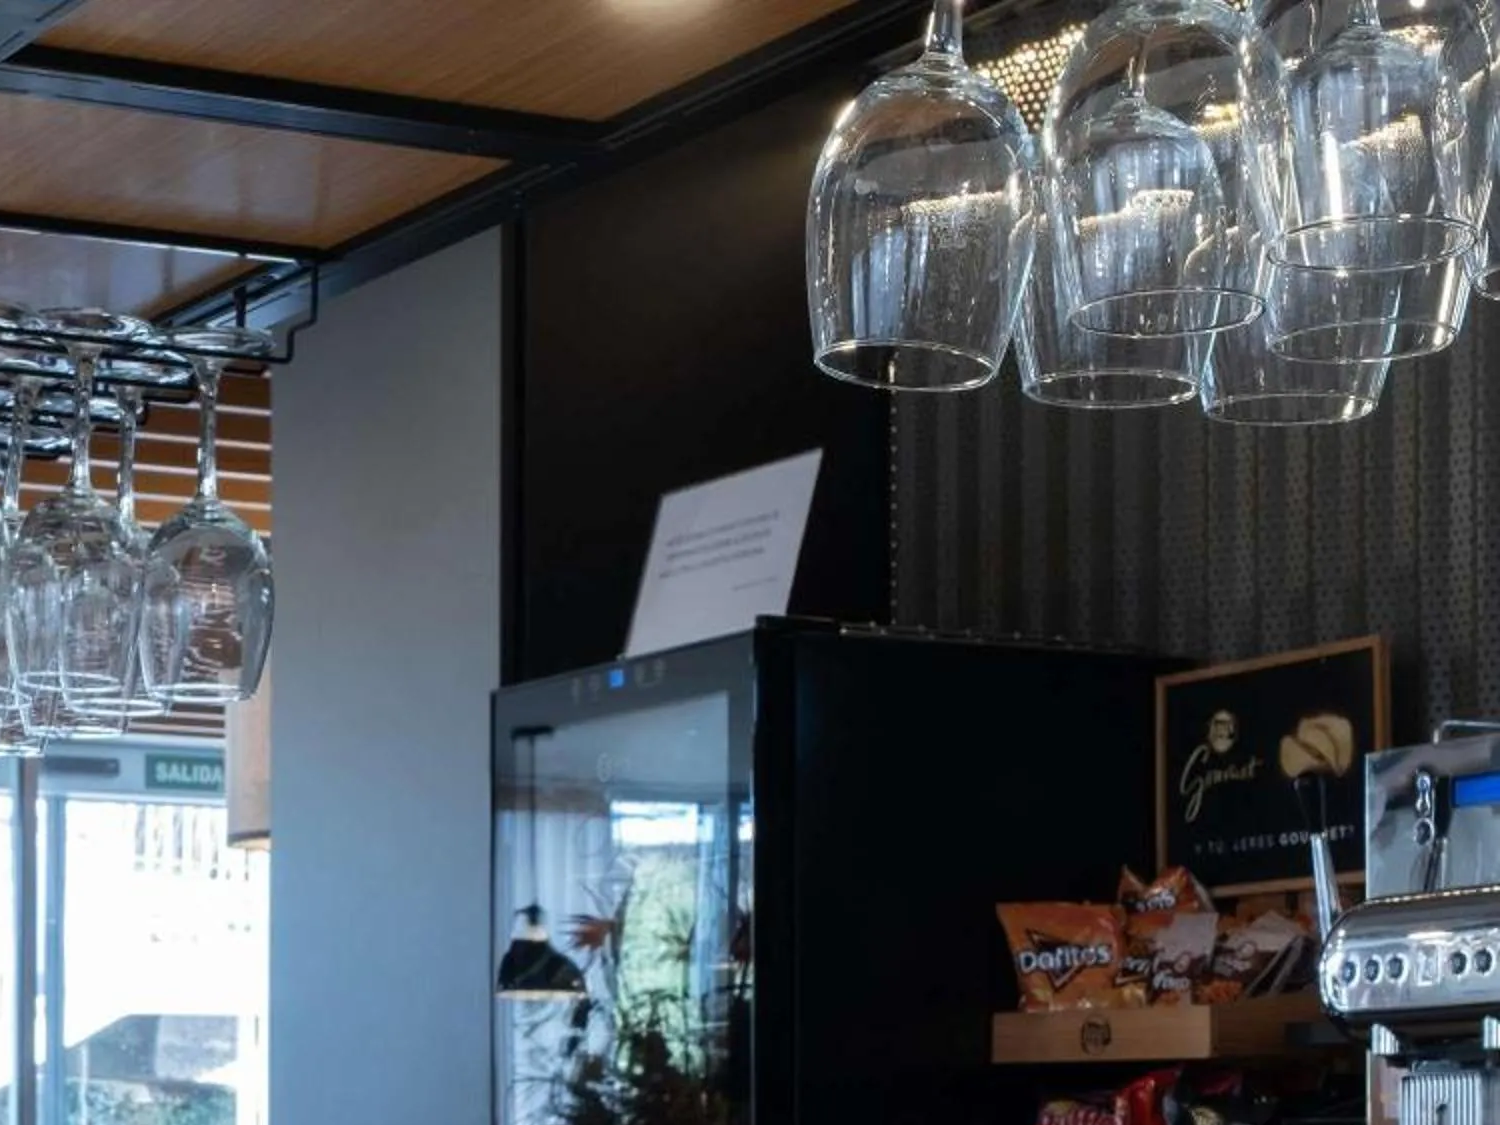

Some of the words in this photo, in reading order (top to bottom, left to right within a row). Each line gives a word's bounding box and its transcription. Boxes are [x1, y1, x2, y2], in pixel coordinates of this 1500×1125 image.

[156, 762, 222, 784] SALIDA
[1279, 825, 1355, 847] GOUET?
[1019, 945, 1110, 974] Doritos
